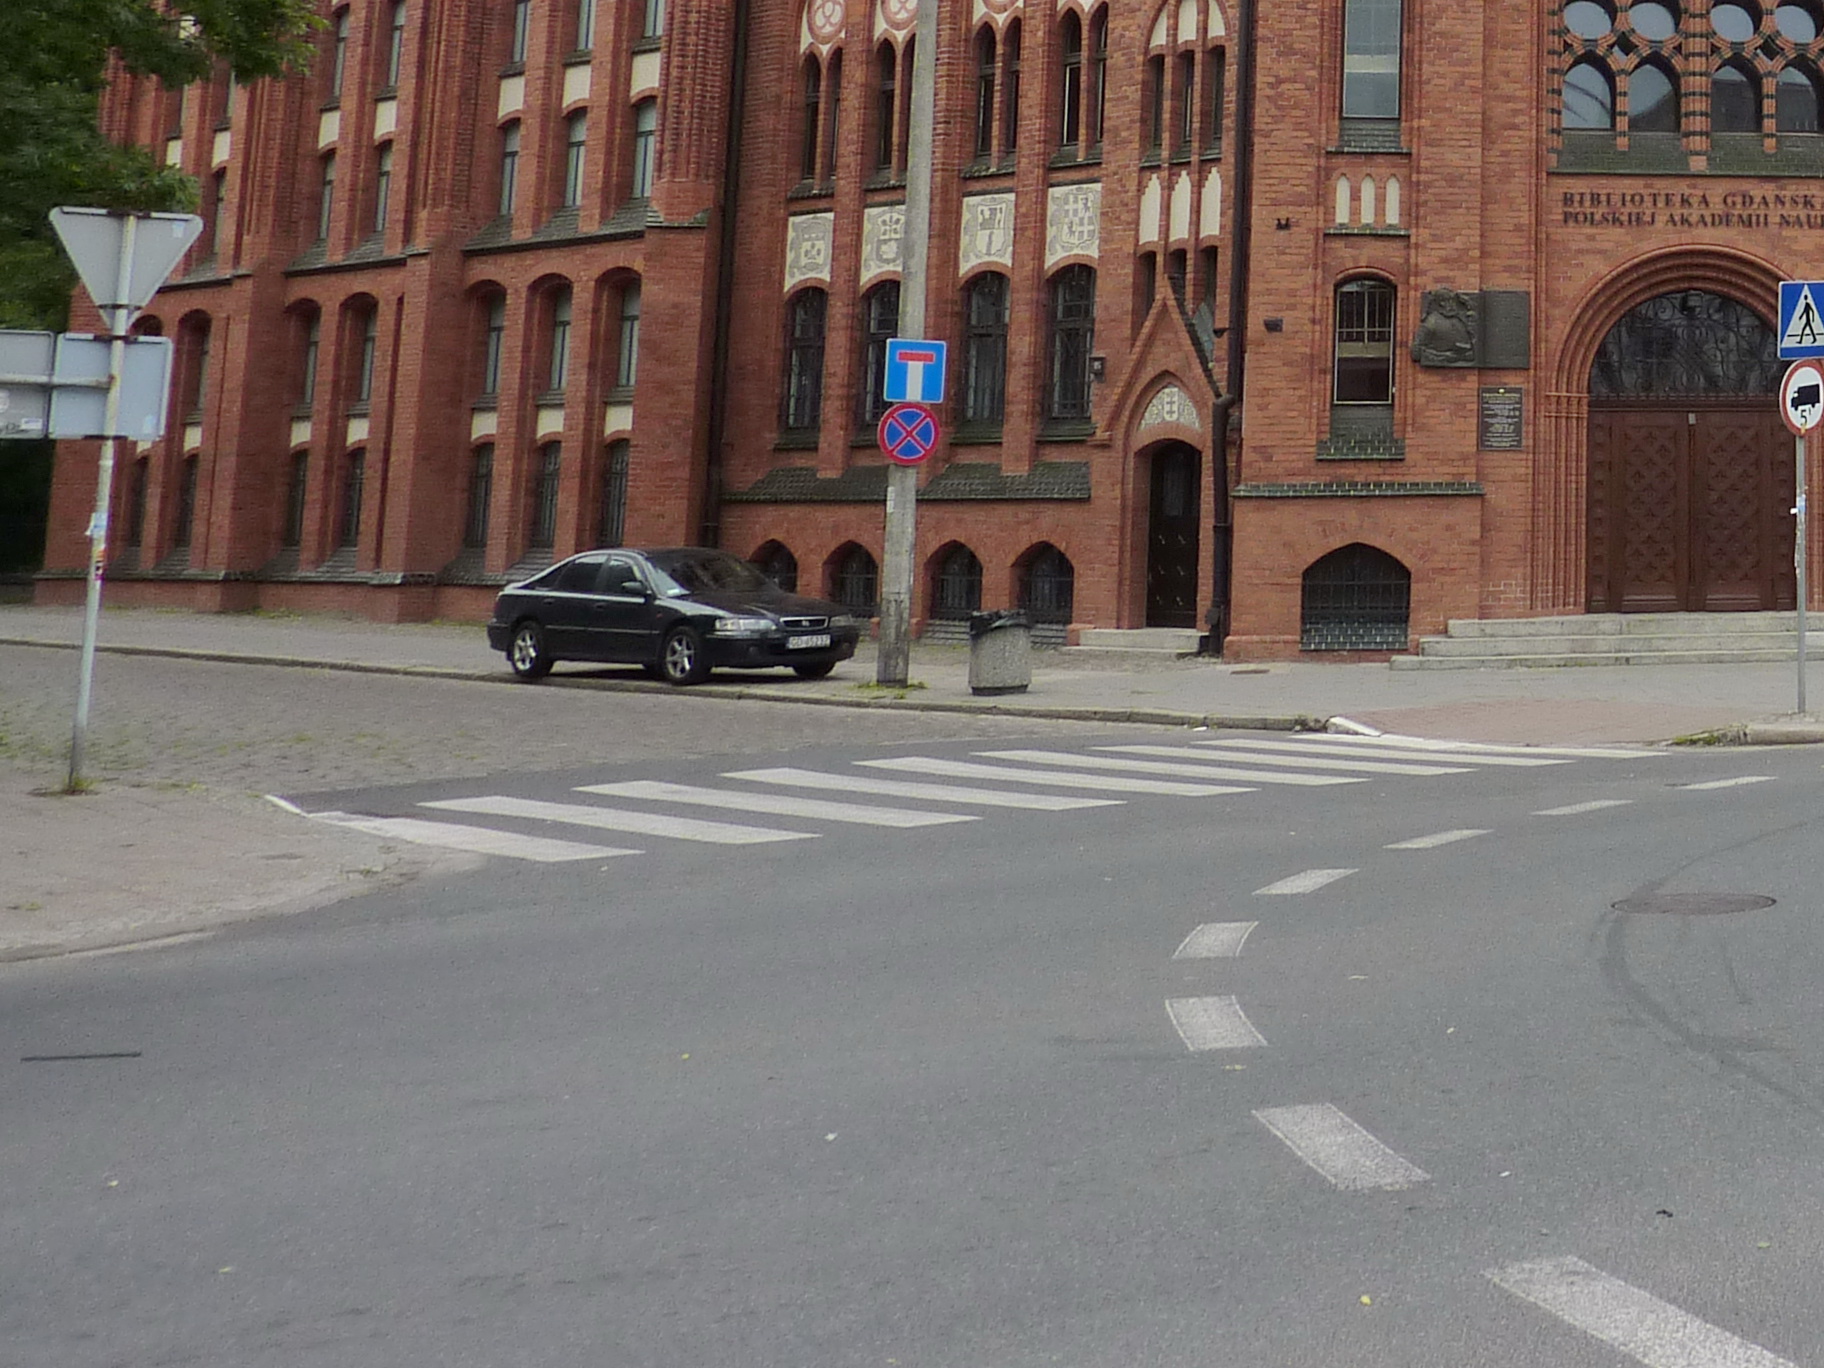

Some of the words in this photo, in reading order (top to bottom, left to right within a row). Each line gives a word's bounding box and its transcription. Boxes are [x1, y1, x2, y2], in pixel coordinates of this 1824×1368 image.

[1563, 191, 1711, 208] BIBLIOTEKA
[1562, 210, 1655, 227] POLSKIEJ
[1664, 212, 1769, 228] AKADEMII
